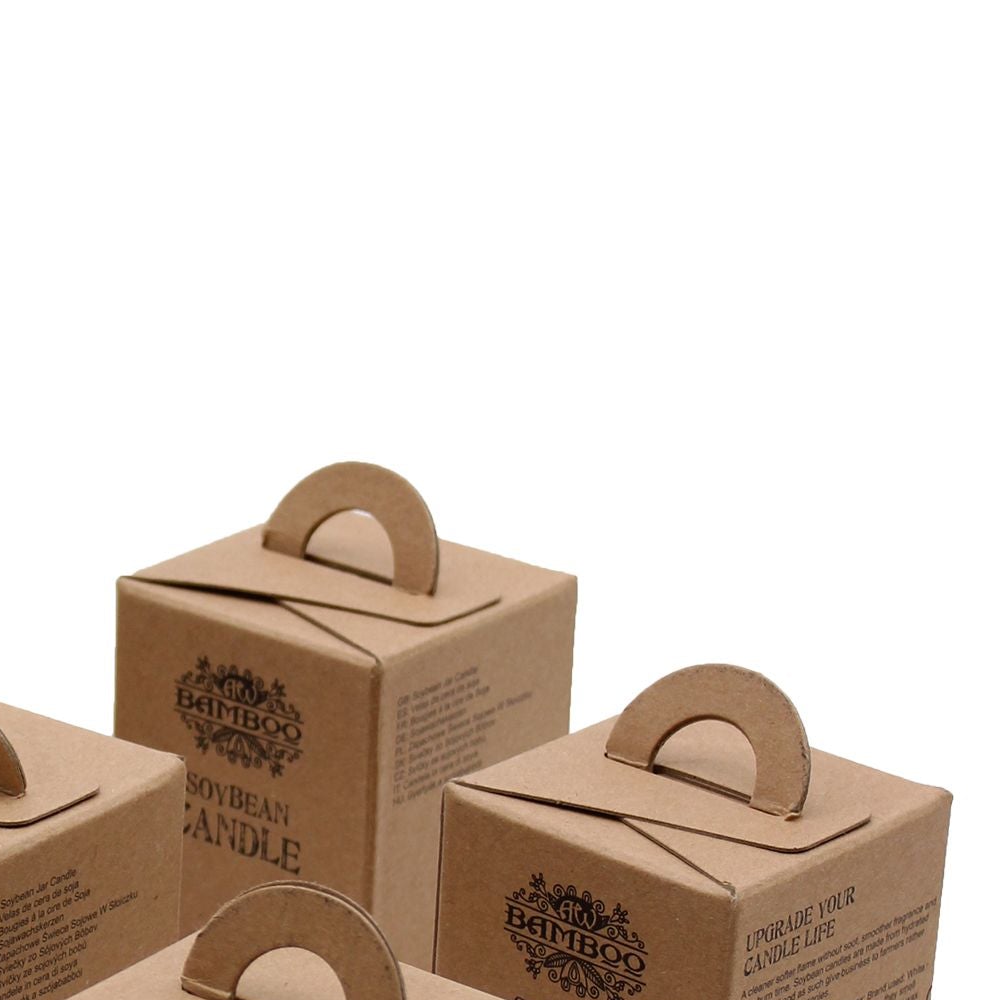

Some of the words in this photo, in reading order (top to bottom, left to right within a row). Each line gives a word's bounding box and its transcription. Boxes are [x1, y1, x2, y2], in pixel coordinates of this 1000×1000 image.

[175, 687, 302, 746] BAMBOO
[186, 771, 290, 827] SOYBEAN
[0, 888, 34, 910] Soybean
[36, 881, 48, 893] Jar
[50, 868, 76, 886] Candle
[746, 905, 813, 952] UPGRADE
[818, 885, 855, 919] YOUR
[505, 903, 646, 977] BAMBOO
[743, 934, 800, 977] CANDLE
[804, 917, 835, 949] LIFE
[747, 979, 773, 996] cleaner
[775, 969, 795, 983] softer
[796, 959, 815, 973] flame
[817, 945, 841, 963] without
[861, 922, 891, 942] smoother
[893, 906, 923, 926] fragrance
[925, 897, 936, 910] and
[793, 967, 823, 987] Soybean
[825, 954, 851, 972] candles
[853, 947, 863, 958] are
[865, 937, 883, 952] made
[885, 929, 899, 942] from
[901, 913, 929, 934] hydrated
[797, 988, 805, 998] as
[807, 978, 823, 992] such
[825, 971, 839, 986] give
[840, 956, 870, 976] business
[871, 952, 878, 961] to
[879, 939, 904, 957] farmers
[905, 929, 924, 944] rather
[33, 972, 49, 985] cera
[866, 983, 886, 1000] Brand
[907, 965, 924, 979] White
[899, 980, 915, 996] smell
